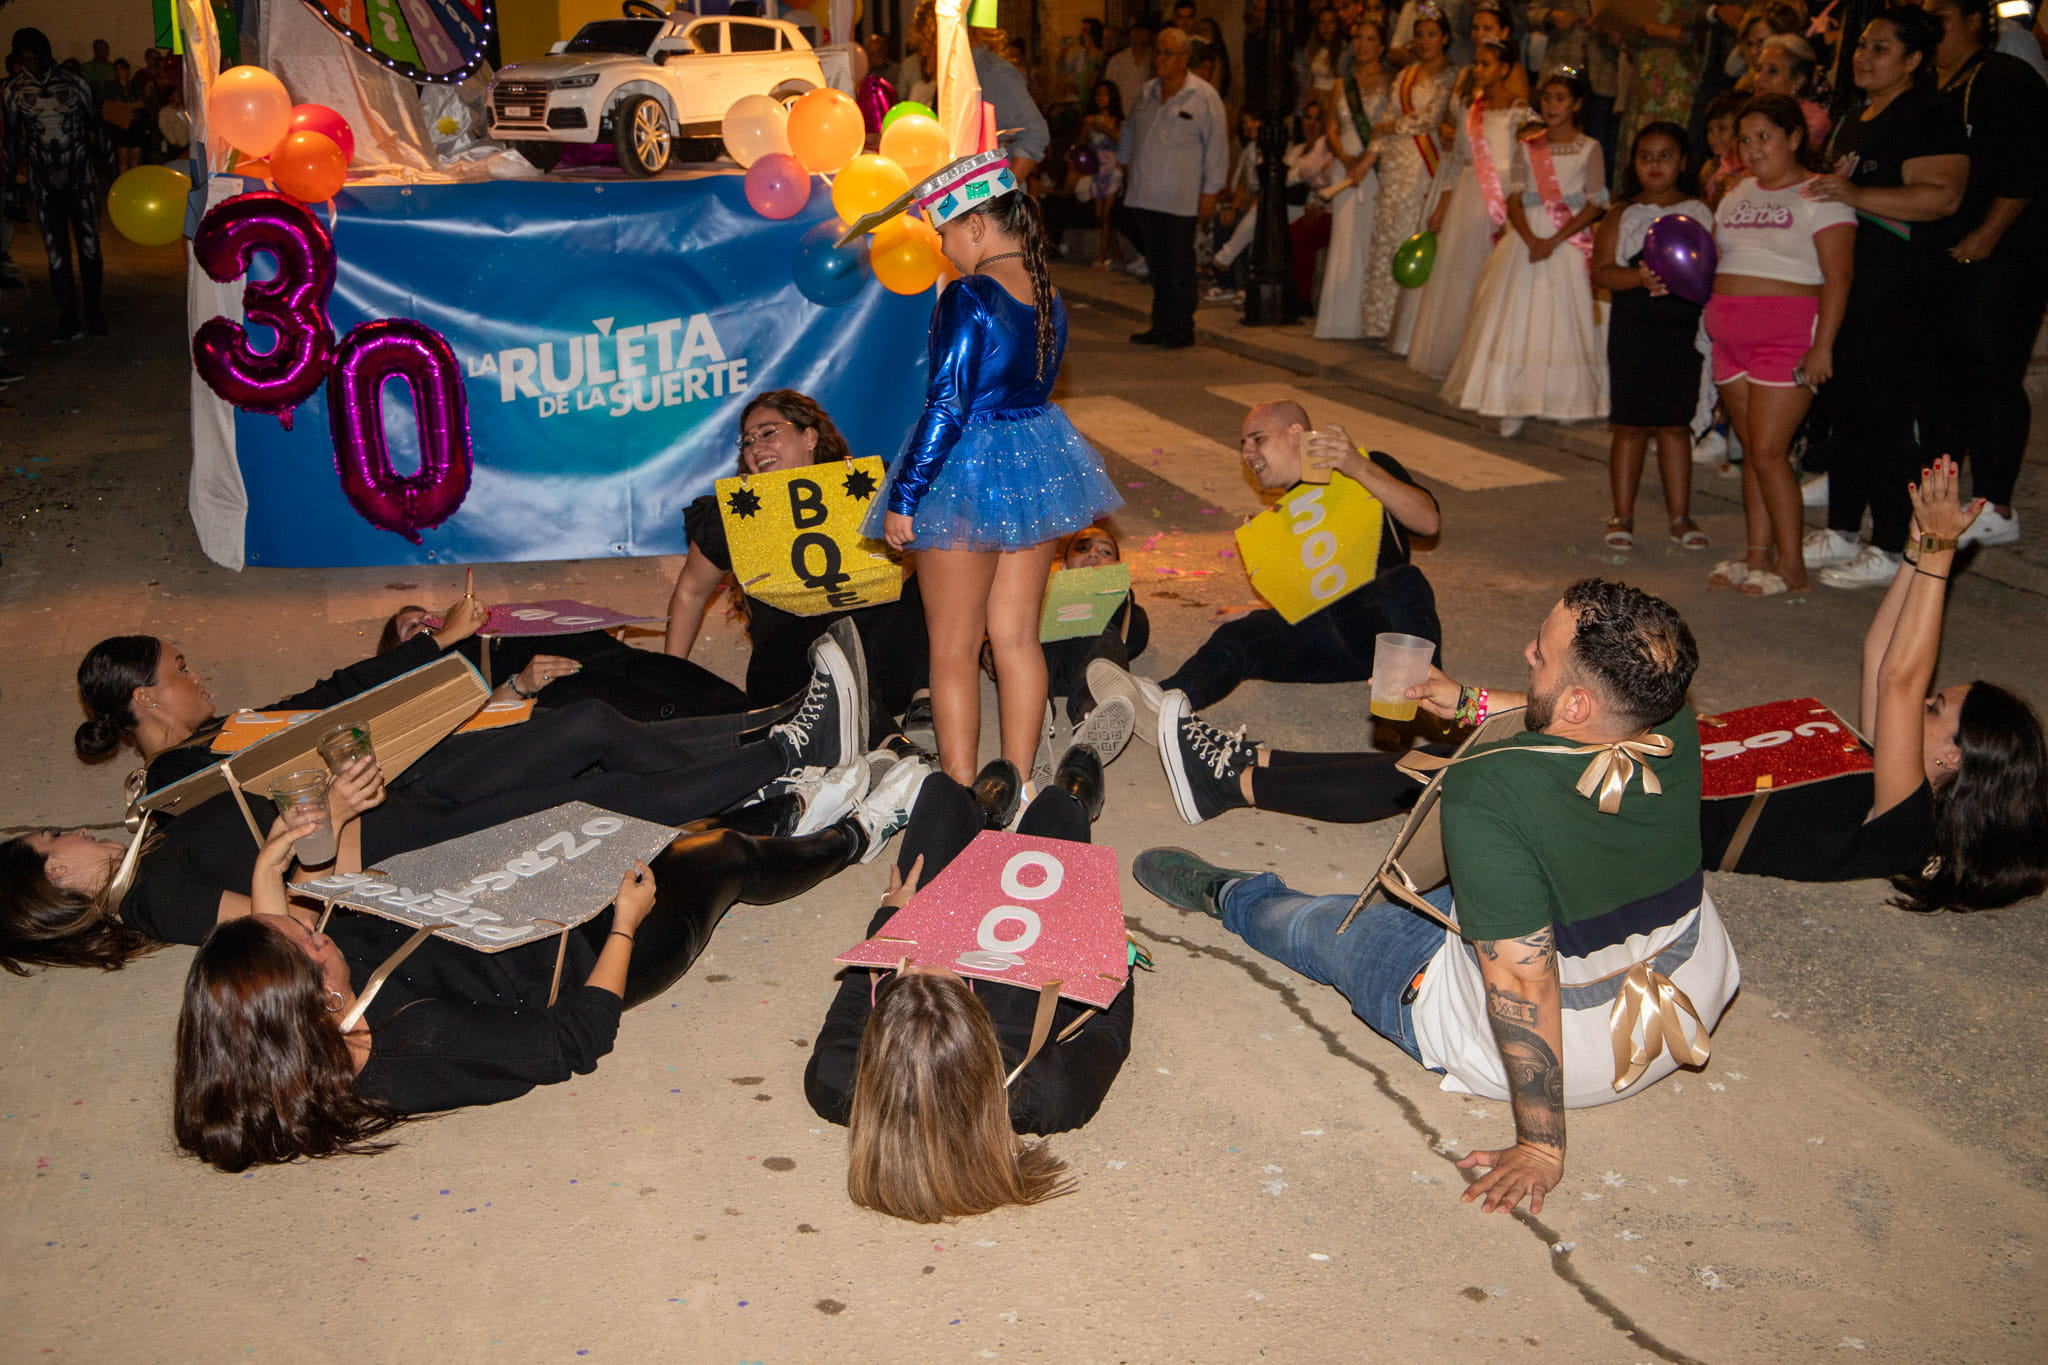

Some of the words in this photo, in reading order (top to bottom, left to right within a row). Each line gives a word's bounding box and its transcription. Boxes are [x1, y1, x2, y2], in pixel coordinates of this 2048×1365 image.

[1723, 201, 1794, 230] Barbie
[467, 353, 499, 379] LA
[499, 312, 727, 403] RULETA
[538, 394, 570, 418] DE
[576, 387, 608, 412] LA
[609, 358, 749, 418] SUERTE
[1288, 487, 1347, 600] 500
